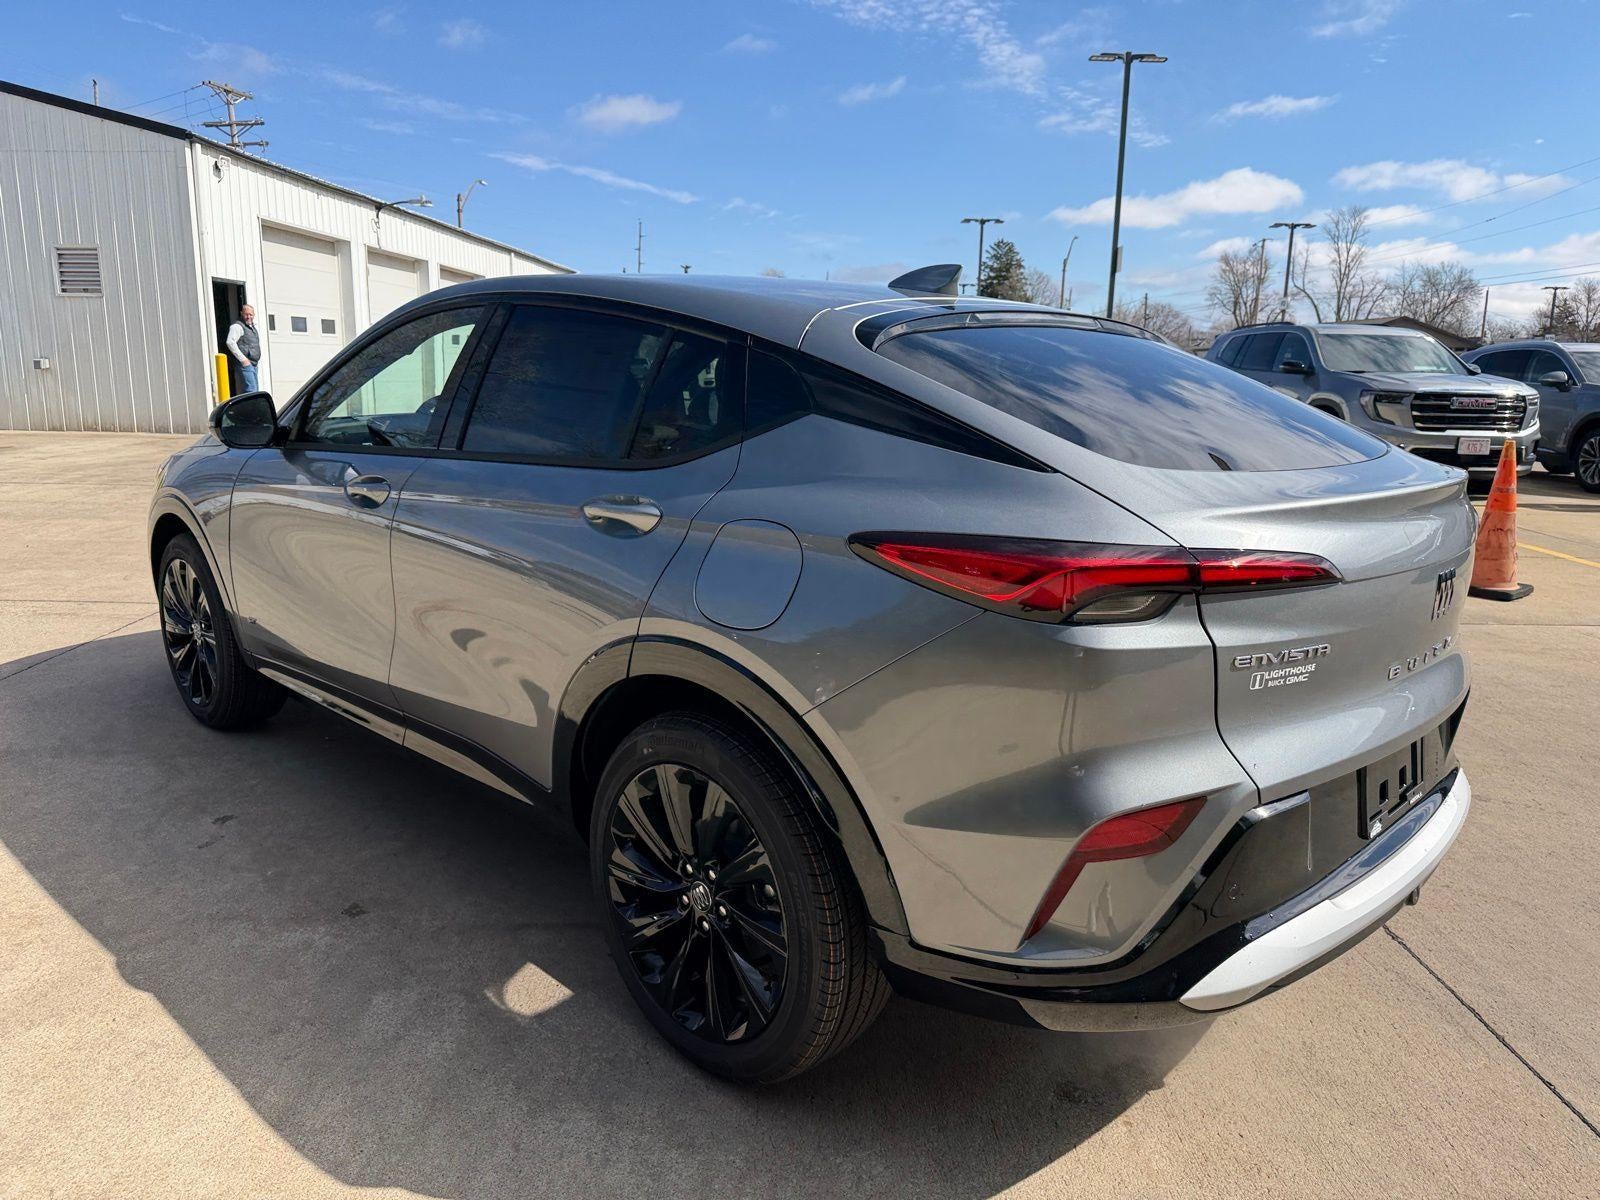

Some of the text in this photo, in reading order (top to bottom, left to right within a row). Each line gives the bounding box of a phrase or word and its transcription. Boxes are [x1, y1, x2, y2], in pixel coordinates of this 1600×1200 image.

[1456, 398, 1496, 409] GMC
[1233, 643, 1331, 668] ENVISTA
[1265, 663, 1317, 679] LIGHTHOUSE
[1286, 673, 1310, 685] GMC
